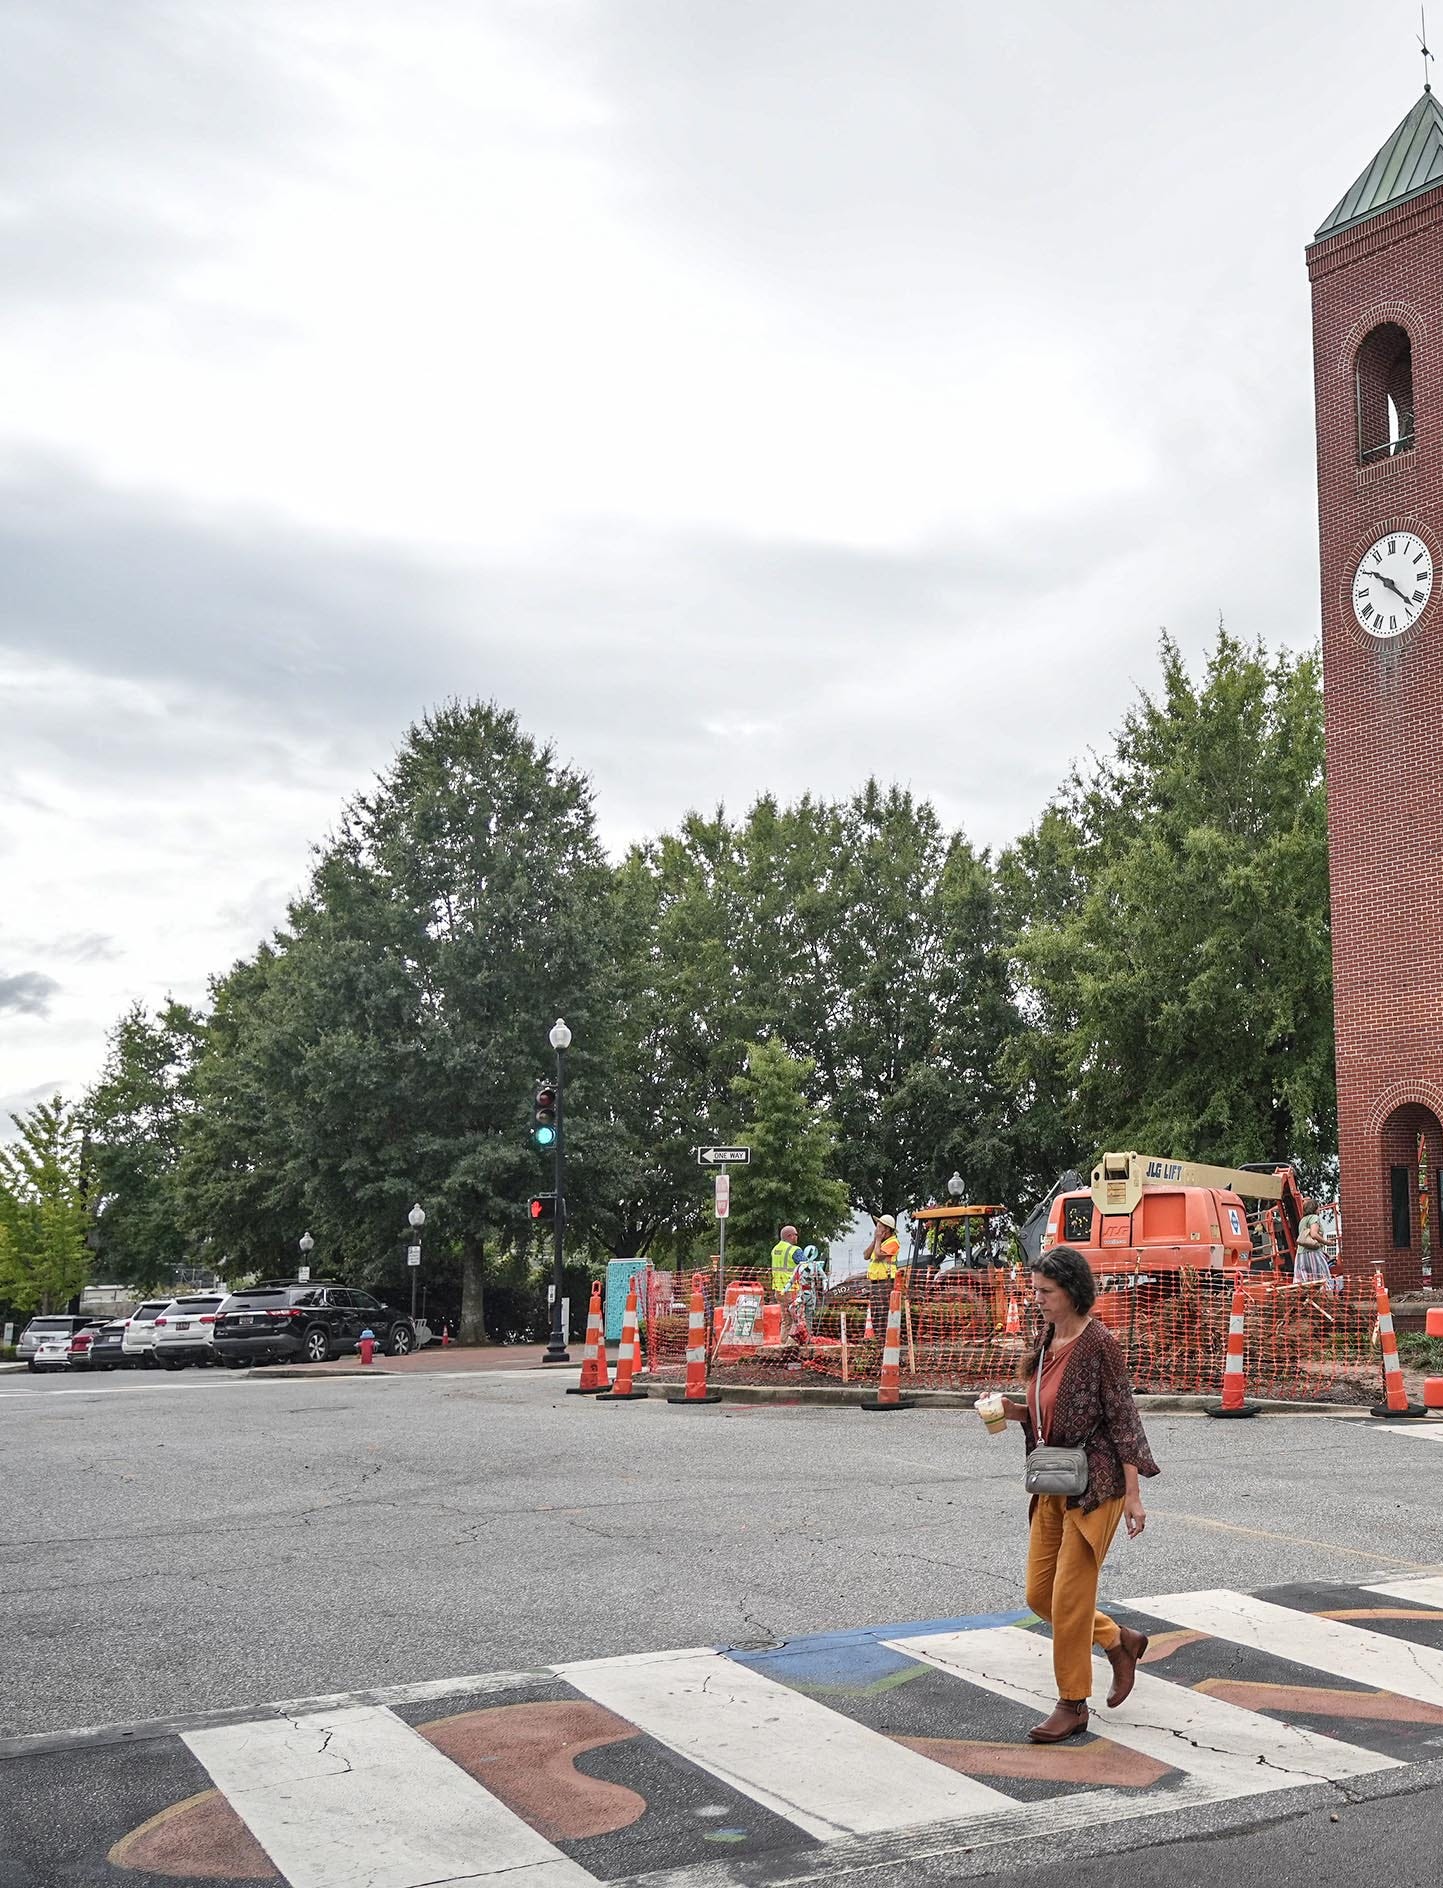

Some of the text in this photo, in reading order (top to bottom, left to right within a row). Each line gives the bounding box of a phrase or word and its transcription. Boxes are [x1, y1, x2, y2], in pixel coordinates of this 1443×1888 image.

[1412, 552, 1424, 565] II
[1416, 571, 1428, 582] III
[1145, 1161, 1183, 1181] JLG LIFT
